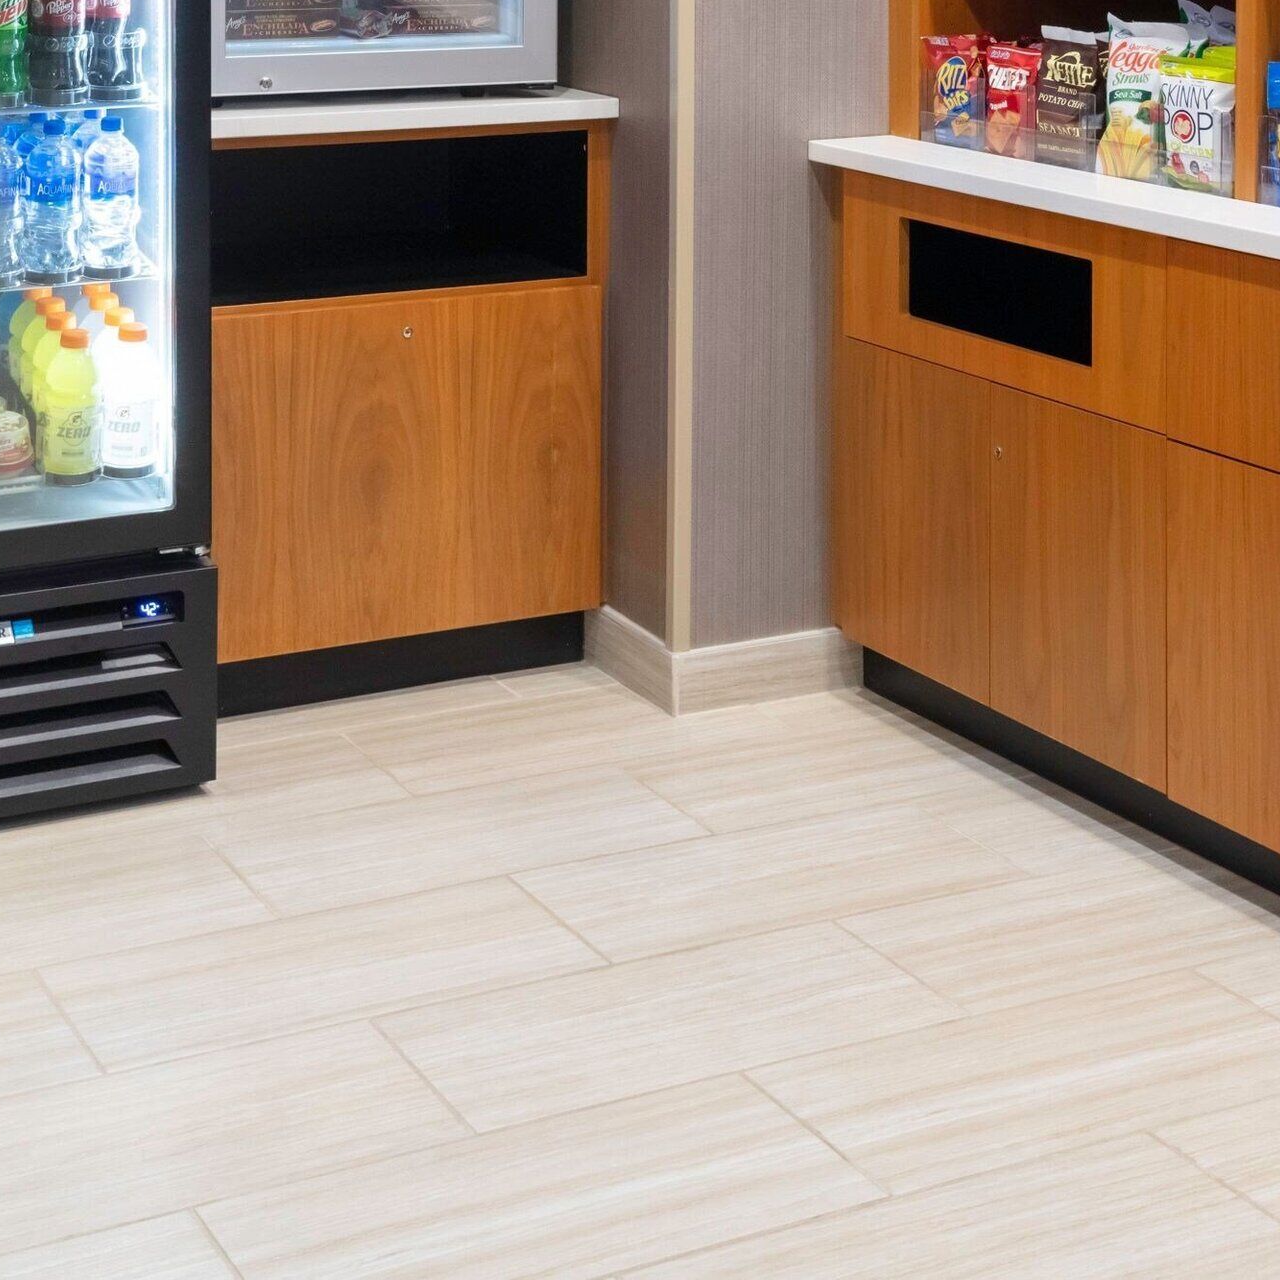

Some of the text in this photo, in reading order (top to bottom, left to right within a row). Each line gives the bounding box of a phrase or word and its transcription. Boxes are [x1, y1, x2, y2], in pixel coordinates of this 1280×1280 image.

[1043, 52, 1097, 88] KETTLE
[938, 63, 967, 94] RITZ
[1113, 72, 1149, 86] Straws
[1058, 86, 1077, 95] BRAND
[1114, 90, 1142, 99] Sea Salt
[1161, 80, 1214, 109] SKINNY
[1039, 93, 1067, 105] POTATO
[1164, 109, 1213, 145] POP
[56, 426, 91, 439] ZERO
[108, 421, 141, 432] ZERO
